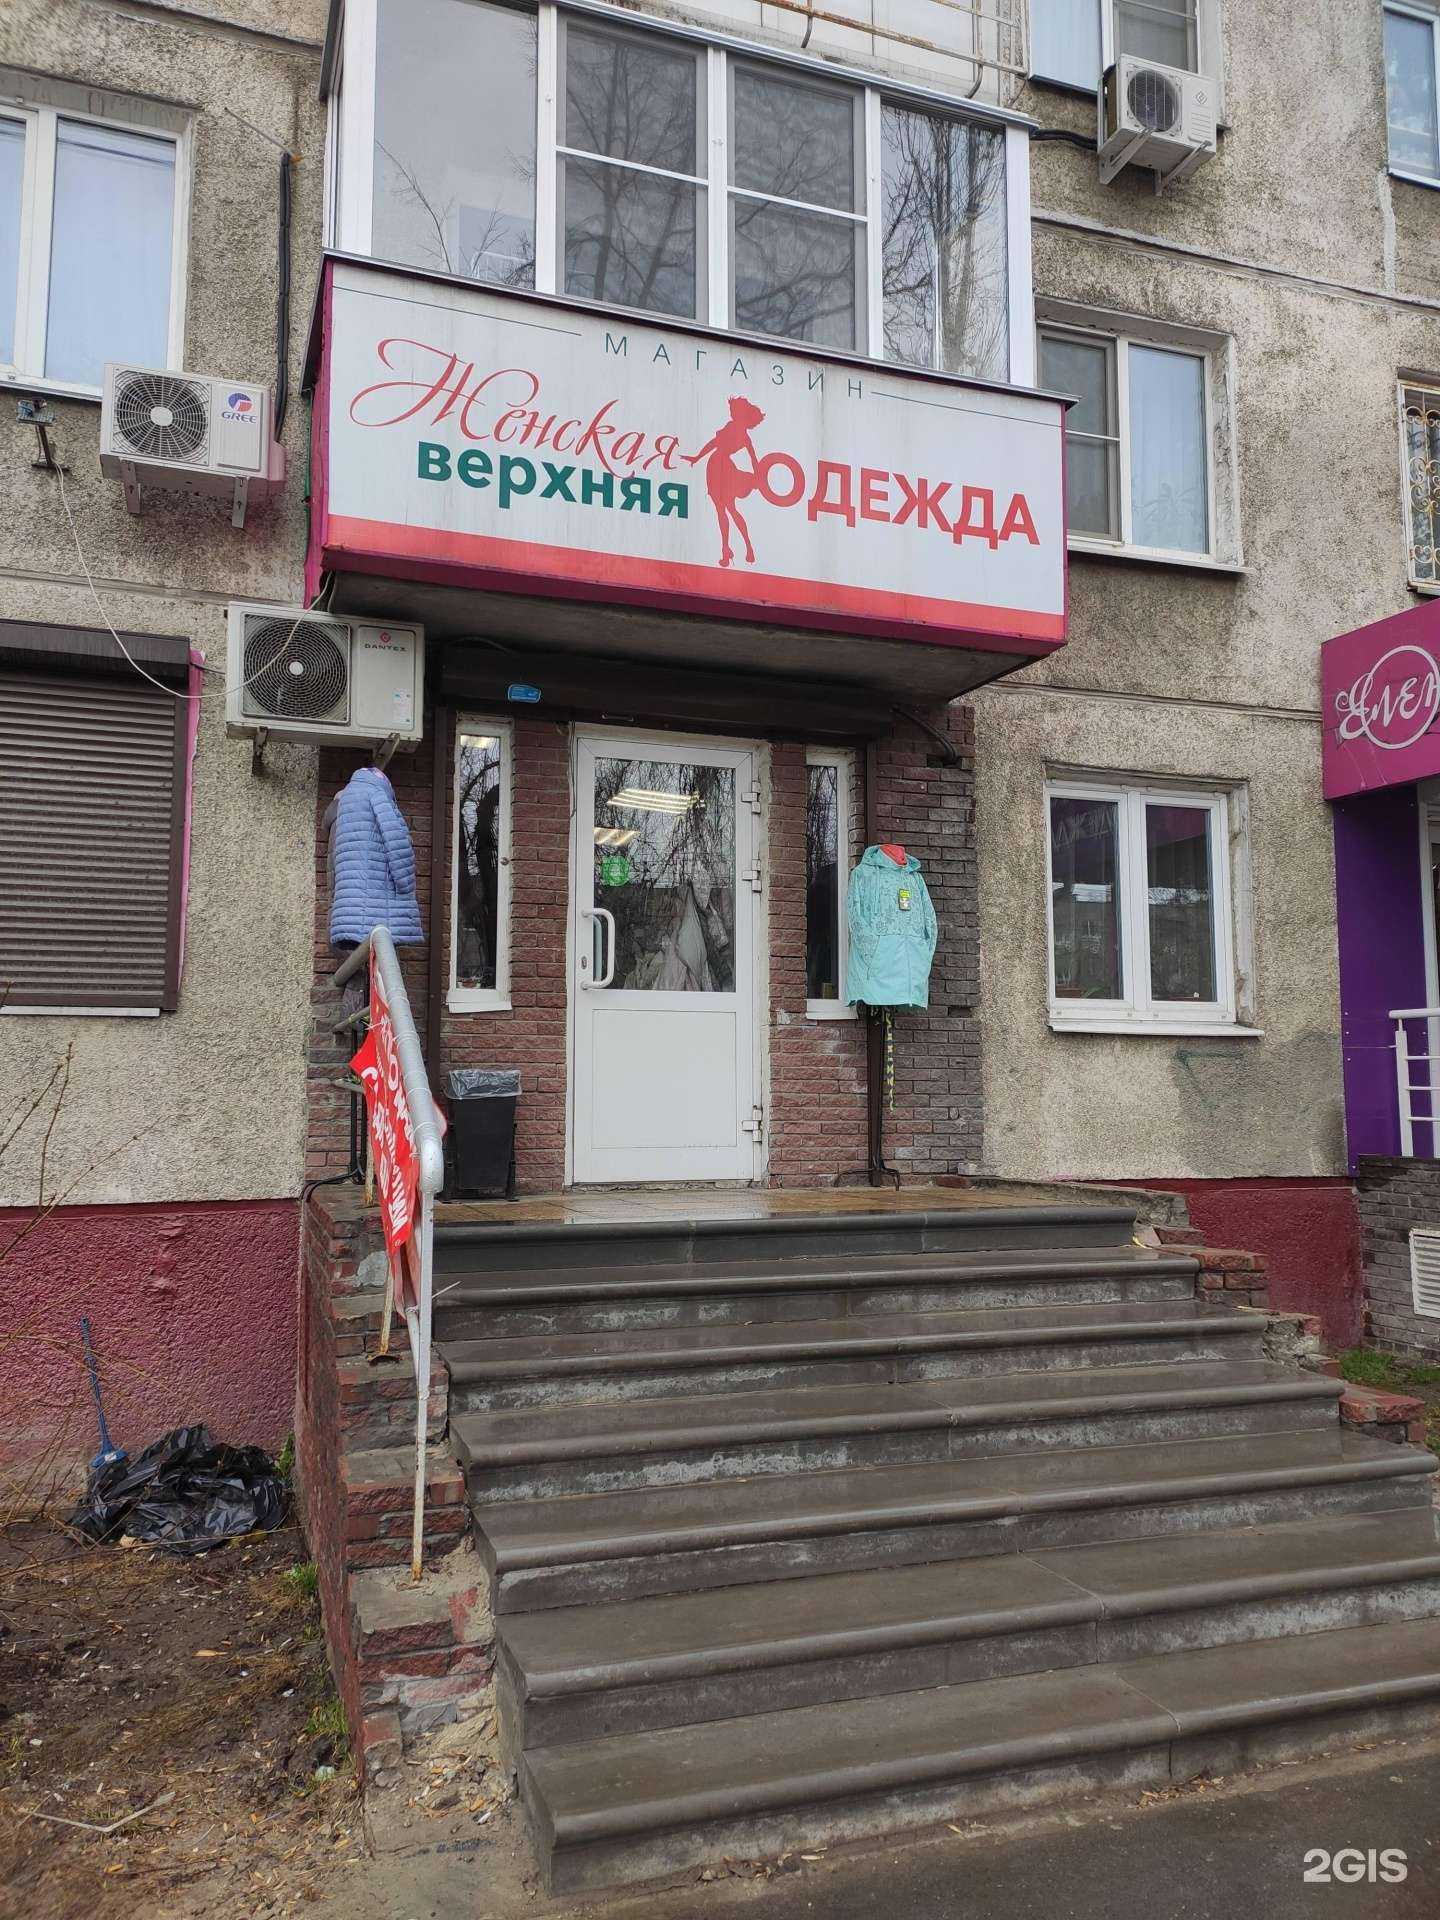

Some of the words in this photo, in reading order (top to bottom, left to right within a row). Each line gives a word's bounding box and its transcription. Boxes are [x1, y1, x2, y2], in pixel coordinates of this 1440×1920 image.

[350, 338, 680, 480] Женская
[604, 332, 863, 400] МАГАЗИН
[221, 411, 258, 424] GREE
[417, 441, 689, 519] верхняя
[757, 452, 1041, 550] ОДЕЖДА
